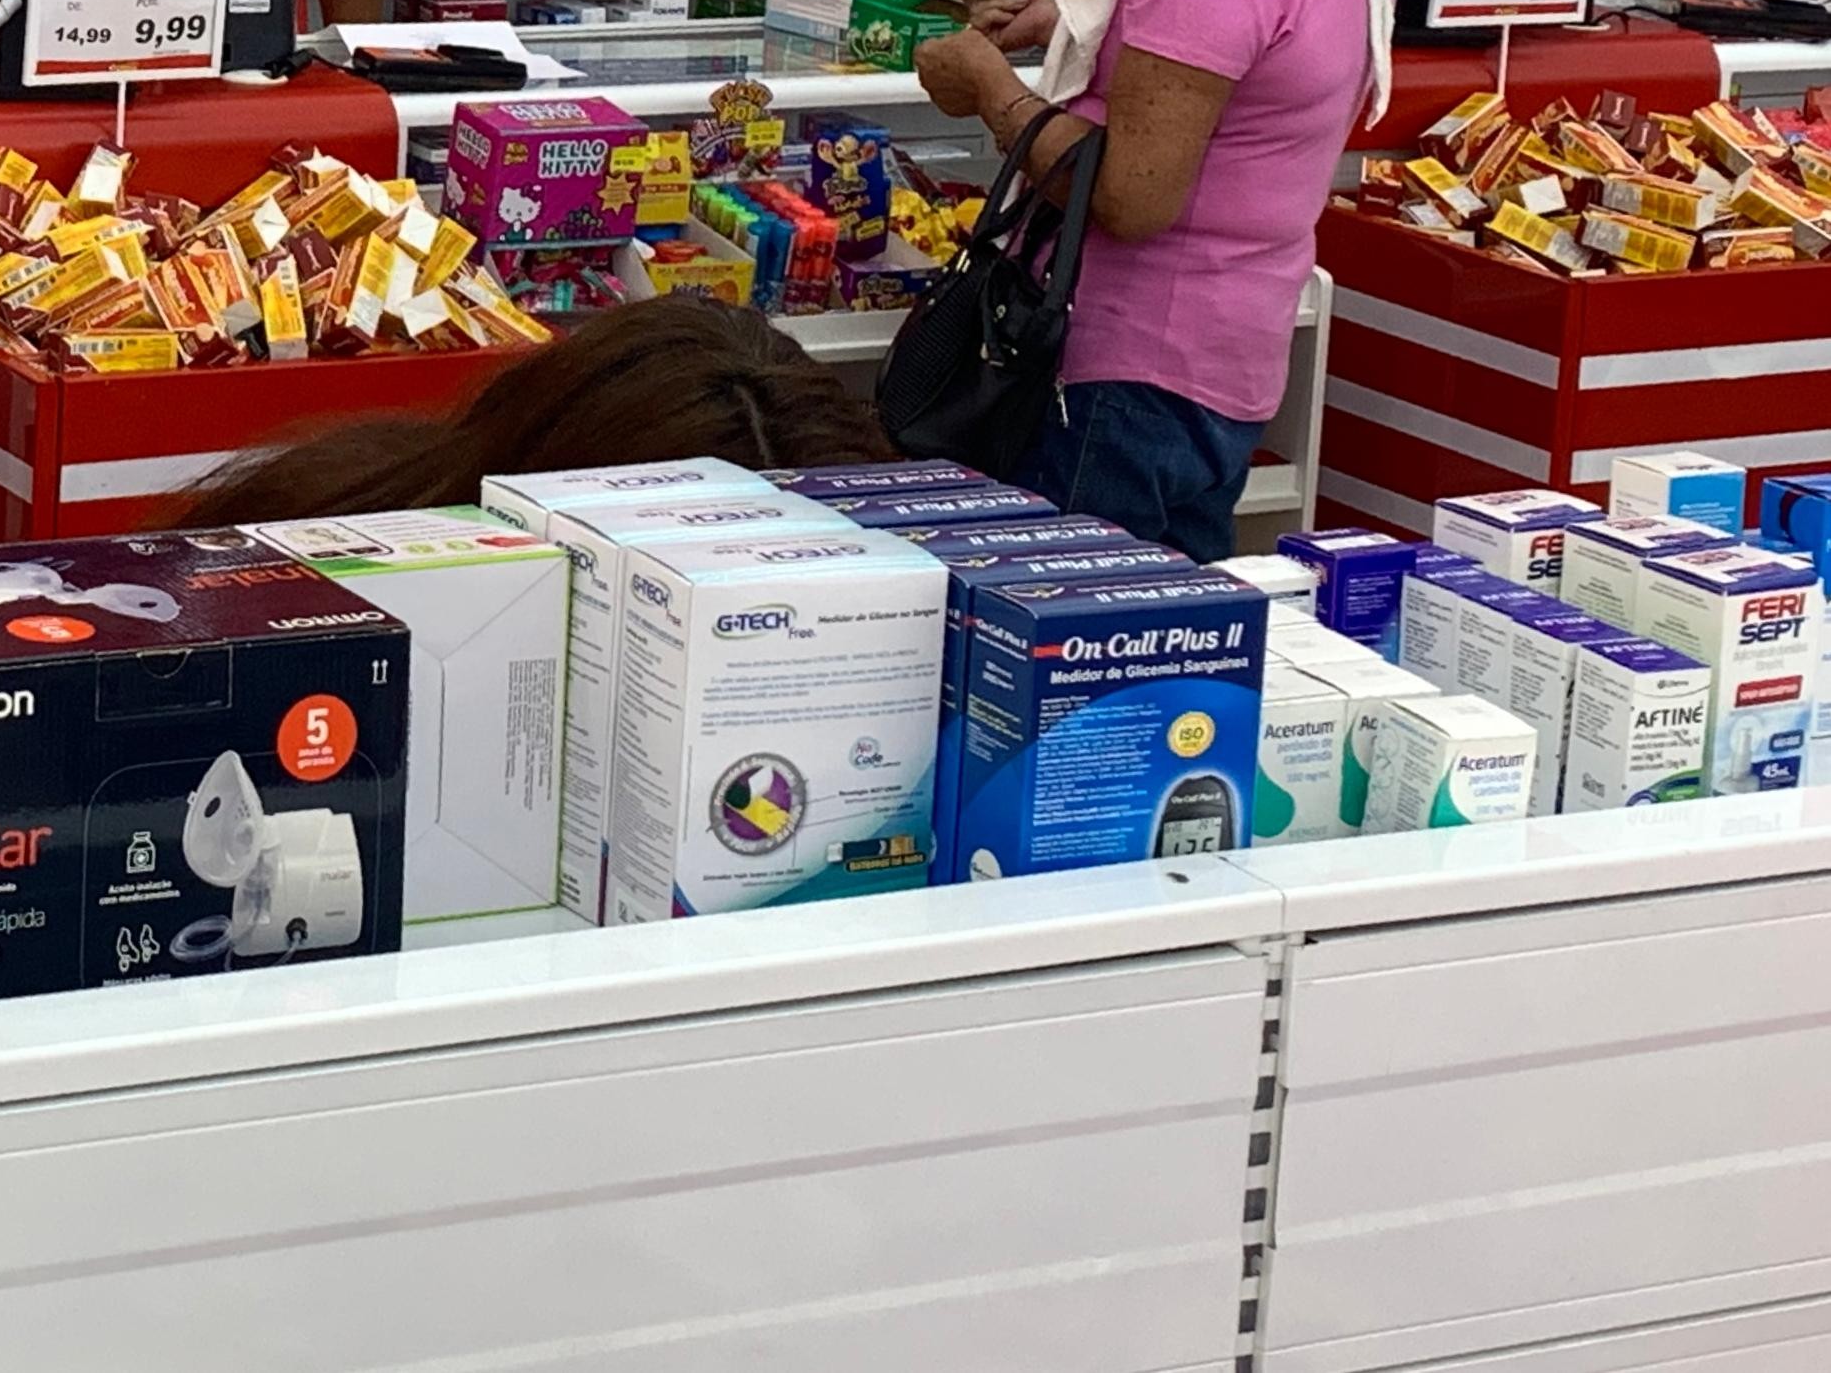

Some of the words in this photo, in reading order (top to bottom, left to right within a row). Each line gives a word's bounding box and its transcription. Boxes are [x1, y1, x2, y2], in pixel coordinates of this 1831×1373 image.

[54, 26, 111, 45] 14,99
[135, 14, 207, 48] 9,99
[541, 140, 606, 159] HELLO
[540, 159, 603, 178] KITTY
[1742, 592, 1807, 623] FERI
[268, 611, 386, 629] OMRON
[1739, 617, 1806, 645] SEPT
[1061, 636, 1103, 662] On
[1108, 630, 1159, 660] Call
[1164, 627, 1220, 653] Plus
[1226, 623, 1244, 648] II
[1050, 668, 1104, 685] Medidor
[1106, 665, 1122, 680] de
[1125, 660, 1181, 679] Glicemia
[306, 708, 329, 745] 5
[1179, 726, 1205, 741] ISO
[1264, 720, 1335, 740] Aceratum
[1457, 753, 1527, 772] Aceratum
